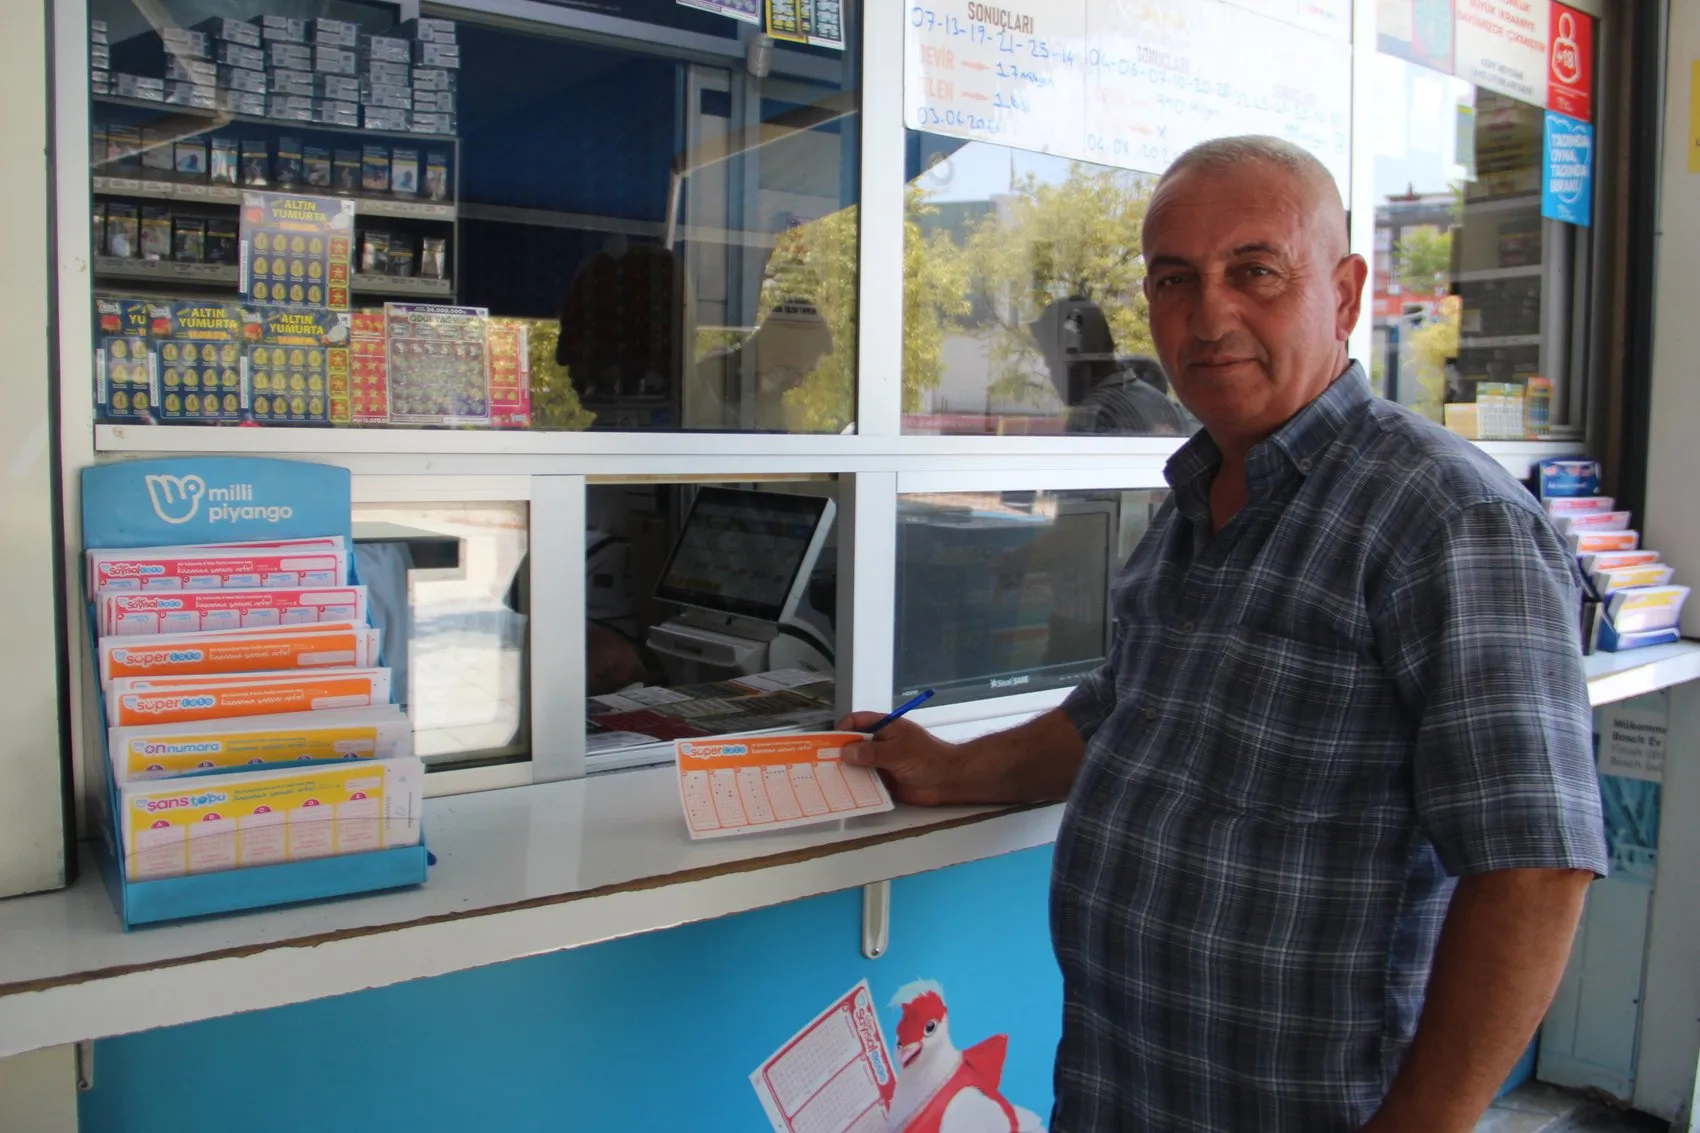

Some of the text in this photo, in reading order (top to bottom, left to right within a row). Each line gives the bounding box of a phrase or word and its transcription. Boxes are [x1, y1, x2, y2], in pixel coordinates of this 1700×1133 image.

[968, 1, 1034, 34] SONUÇLARI
[284, 199, 316, 211] ALTIN
[272, 208, 328, 222] YUMURTA
[191, 307, 225, 318] ALTIN
[179, 317, 238, 329] YUMURTA
[280, 313, 314, 325] ALTIN
[269, 323, 324, 335] YUMURTA
[208, 483, 253, 501] milli
[208, 503, 293, 523] piyango
[1611, 731, 1645, 744] Bosch
[145, 743, 219, 754] on numara
[190, 793, 225, 807] topu
